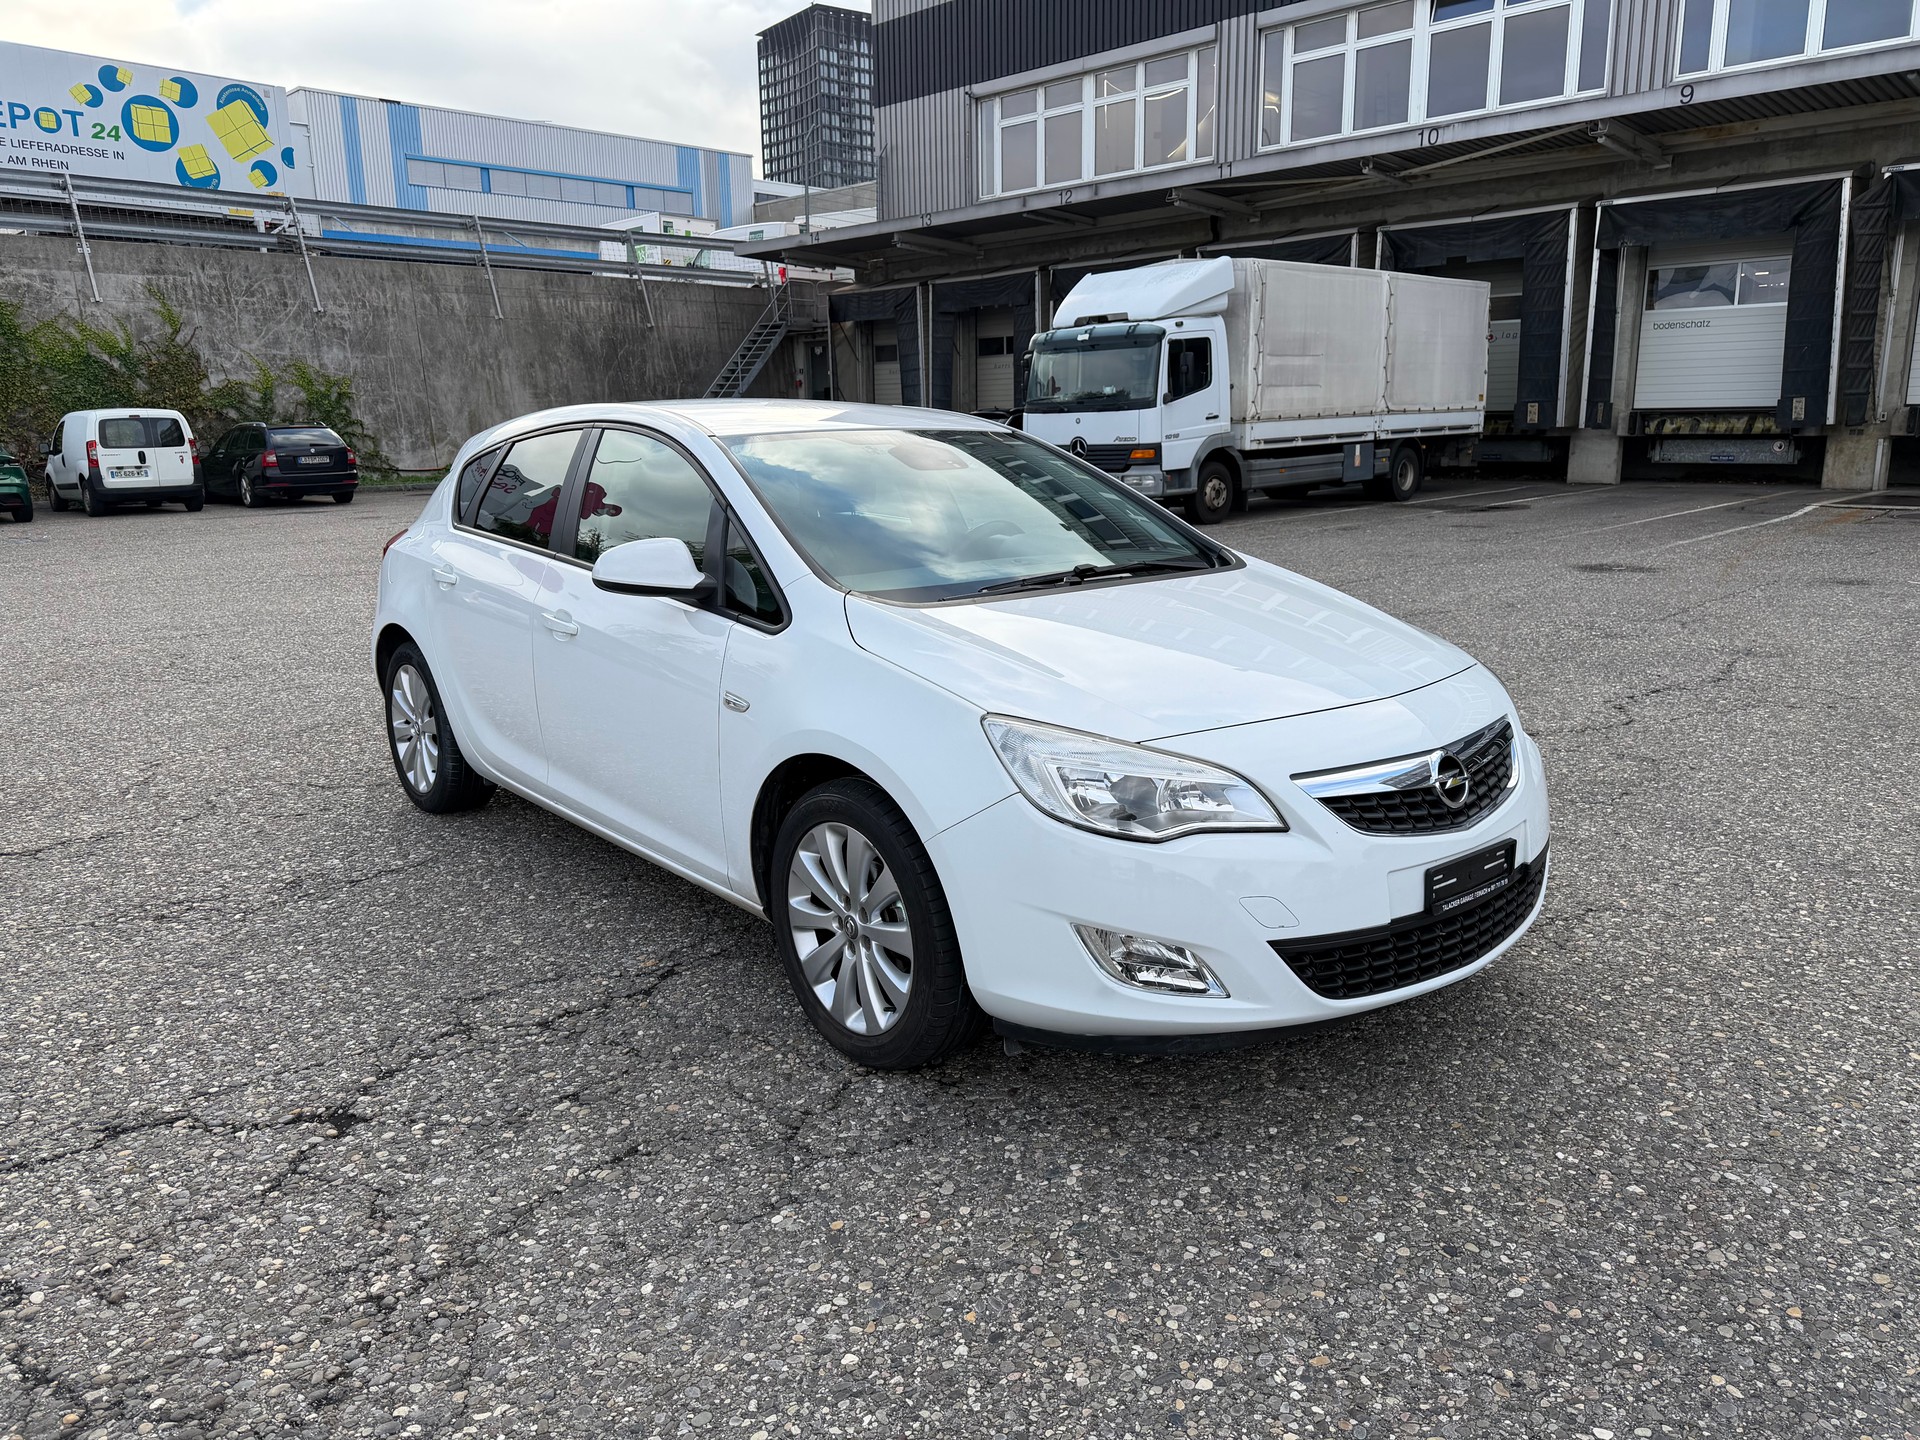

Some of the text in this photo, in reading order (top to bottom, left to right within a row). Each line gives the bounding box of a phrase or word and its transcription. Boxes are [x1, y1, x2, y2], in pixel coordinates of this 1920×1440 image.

[1679, 84, 1694, 104] 9
[91, 122, 121, 142] 24
[1417, 128, 1440, 147] 10
[10, 138, 109, 159] LIEFERADRESSE
[113, 150, 125, 160] IN
[7, 155, 69, 170] AM RHEIN
[1218, 162, 1232, 179] 11
[1059, 190, 1072, 205] 12
[920, 212, 932, 227] 13
[810, 231, 820, 244] 14
[1653, 320, 1711, 330] bodenschatz
[1460, 893, 1474, 904] GARAGE
